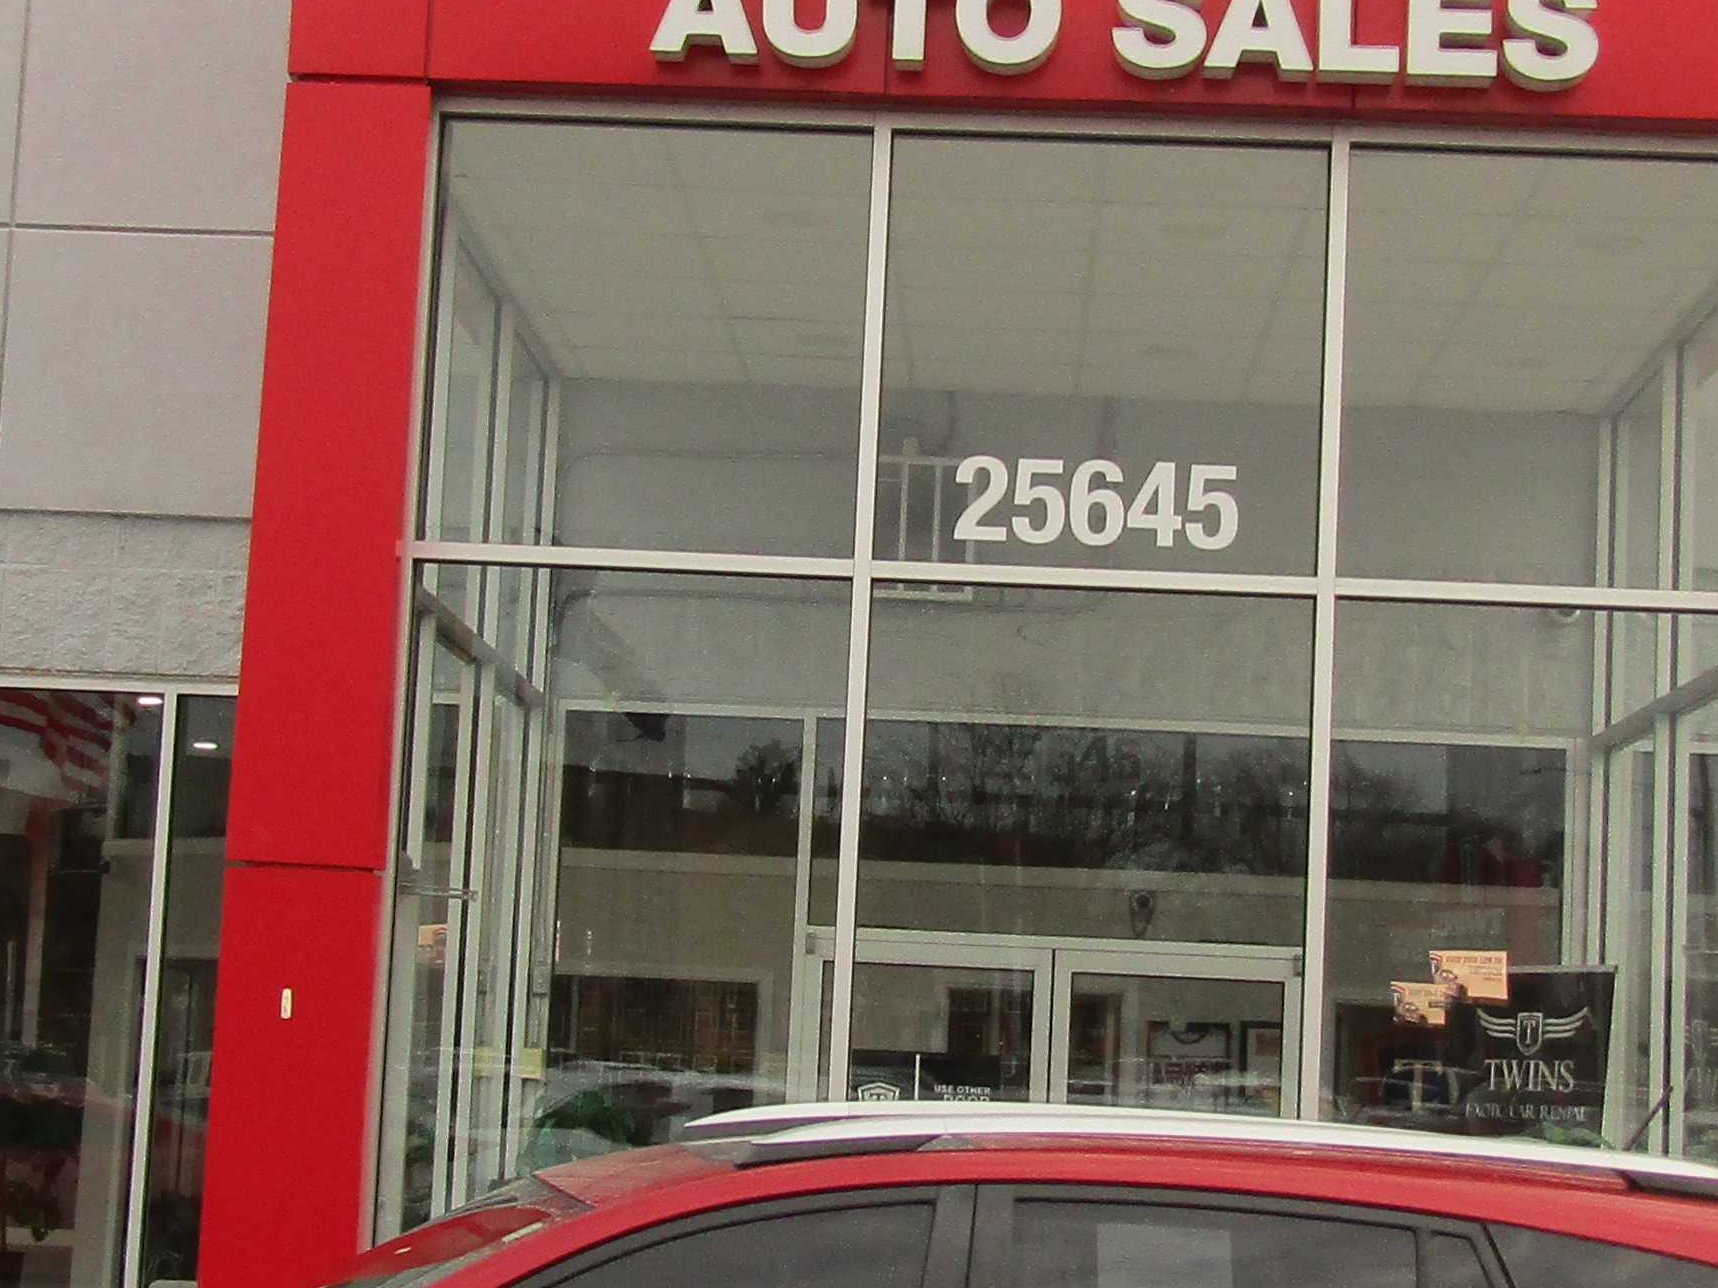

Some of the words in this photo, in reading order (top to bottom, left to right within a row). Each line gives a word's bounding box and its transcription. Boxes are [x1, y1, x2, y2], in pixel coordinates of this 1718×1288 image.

[952, 454, 1240, 552] 25645
[933, 1083, 956, 1094] USE
[956, 1085, 991, 1096] OTHER
[1483, 1058, 1576, 1094] TWINS
